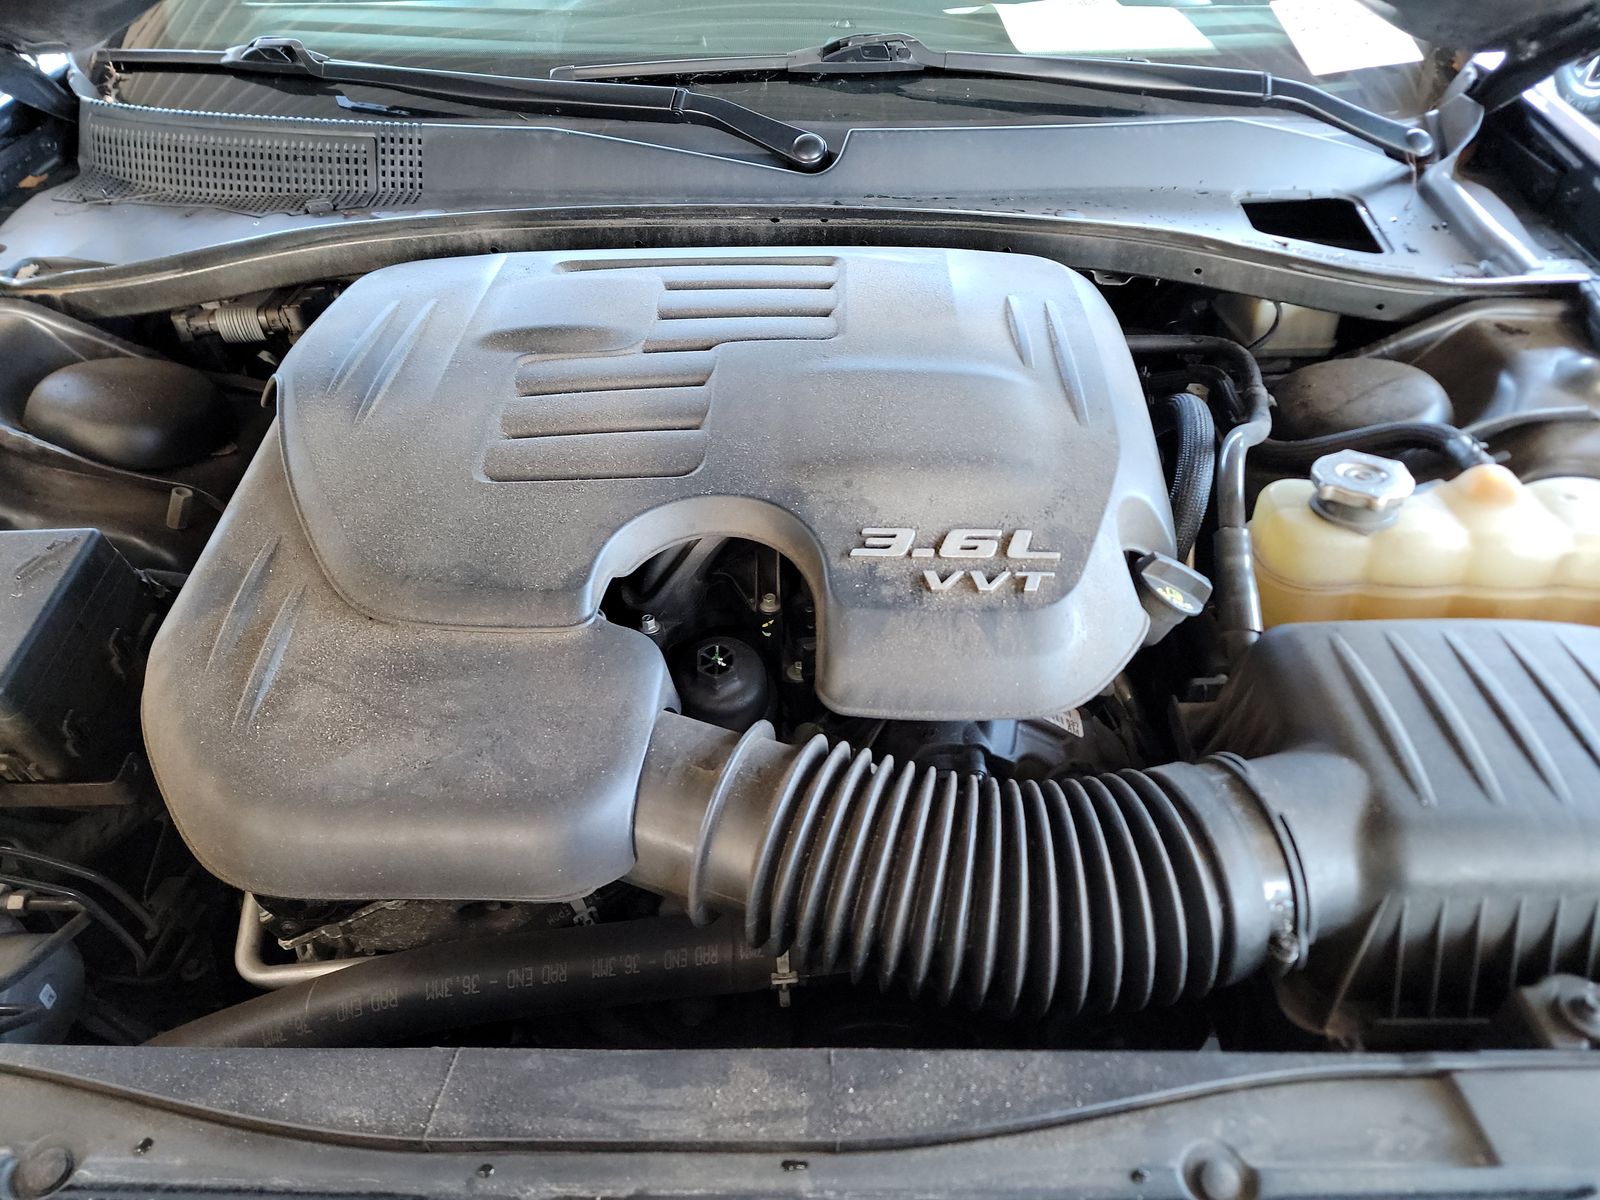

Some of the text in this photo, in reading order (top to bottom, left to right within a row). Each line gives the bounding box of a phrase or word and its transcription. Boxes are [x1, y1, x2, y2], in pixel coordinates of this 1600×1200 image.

[849, 527, 1062, 560] 3.6L
[923, 570, 1056, 593] VVT
[591, 953, 641, 979] 36.3MM
[664, 949, 688, 970] END
[695, 945, 719, 967] RAD
[506, 966, 534, 989] END
[542, 961, 568, 985] RAD
[425, 974, 481, 1001] 36.3MM
